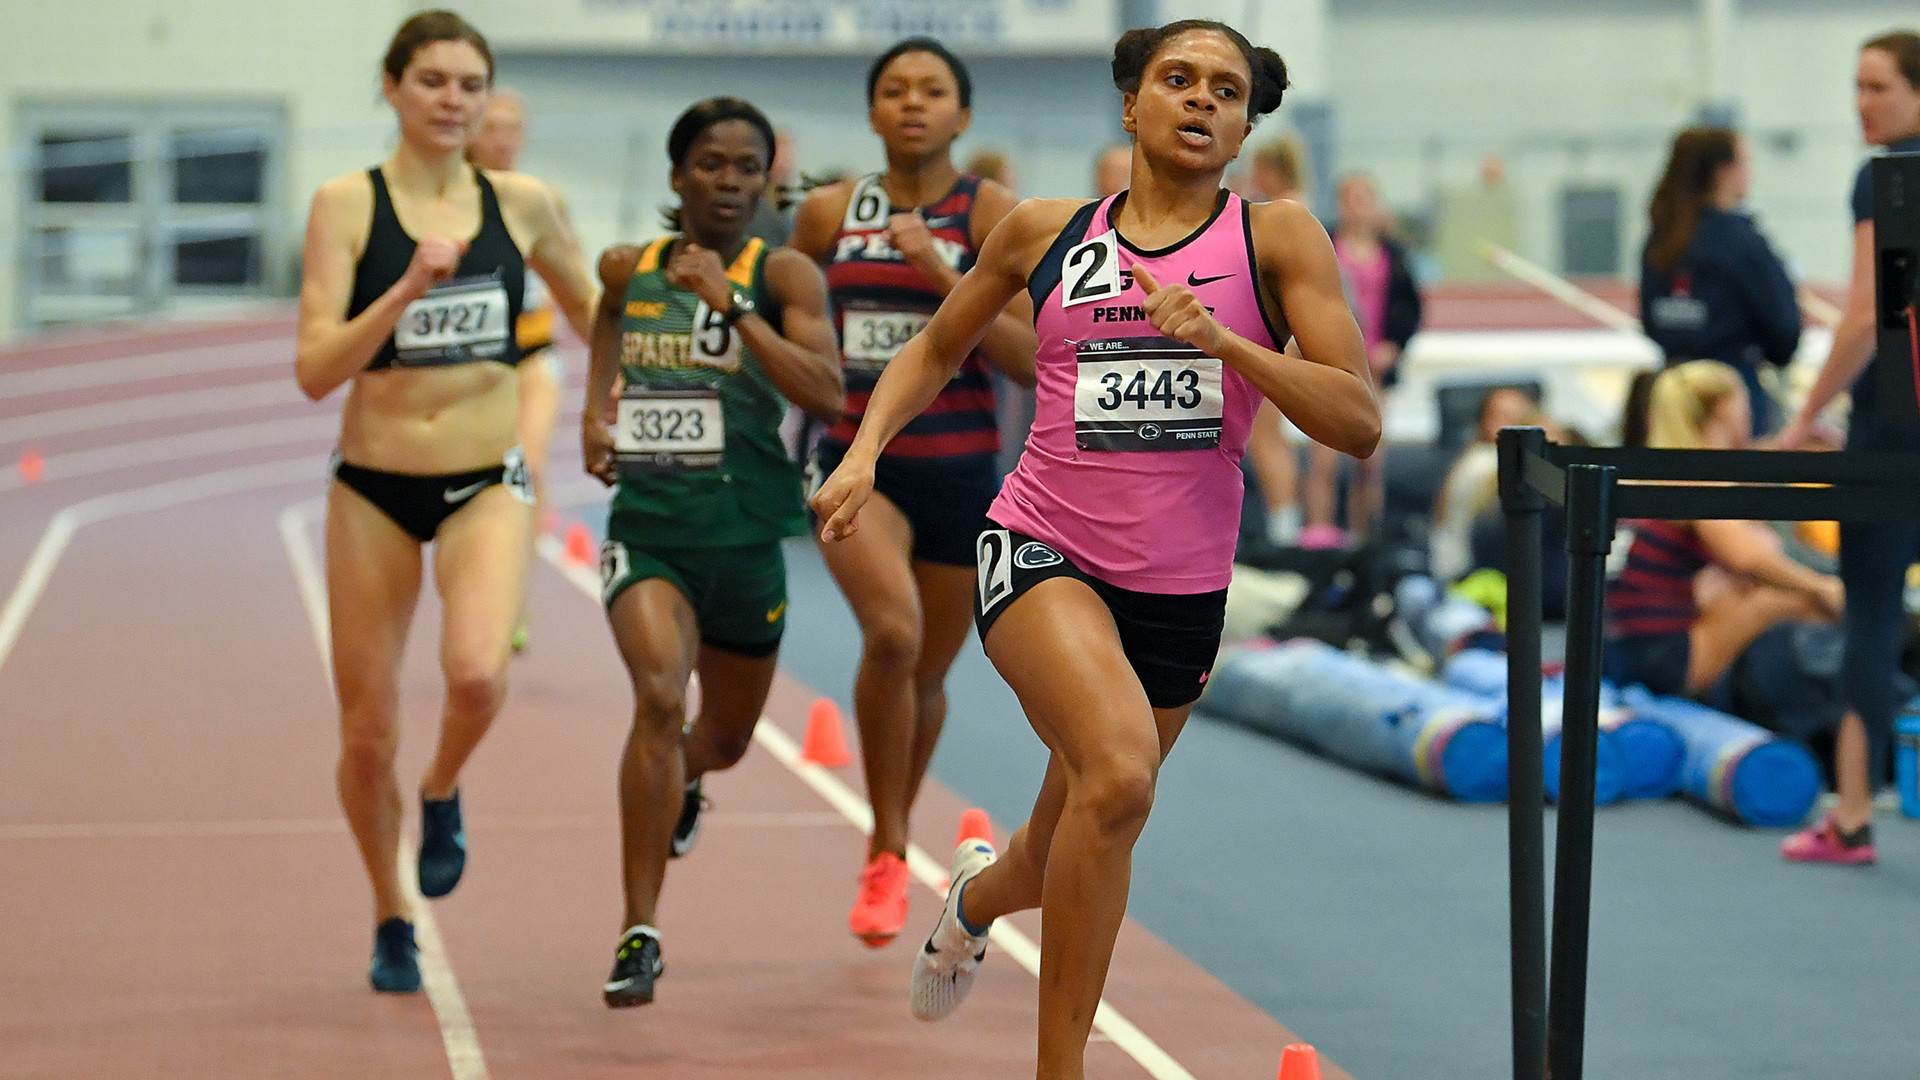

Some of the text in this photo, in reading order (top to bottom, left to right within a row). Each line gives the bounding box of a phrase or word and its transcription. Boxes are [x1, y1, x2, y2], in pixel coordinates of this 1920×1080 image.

[856, 176, 879, 222] 6
[833, 234, 964, 269] PEN
[1069, 242, 1112, 301] 2
[413, 303, 488, 336] 3727
[1093, 306, 1146, 323] PENN
[700, 309, 730, 357] 5
[861, 319, 928, 350] 334
[1089, 342, 1104, 350] WE
[1097, 369, 1202, 411] 3443
[632, 409, 704, 440] 3323
[1176, 431, 1218, 440] PENN STATE
[980, 532, 1005, 608] 2
